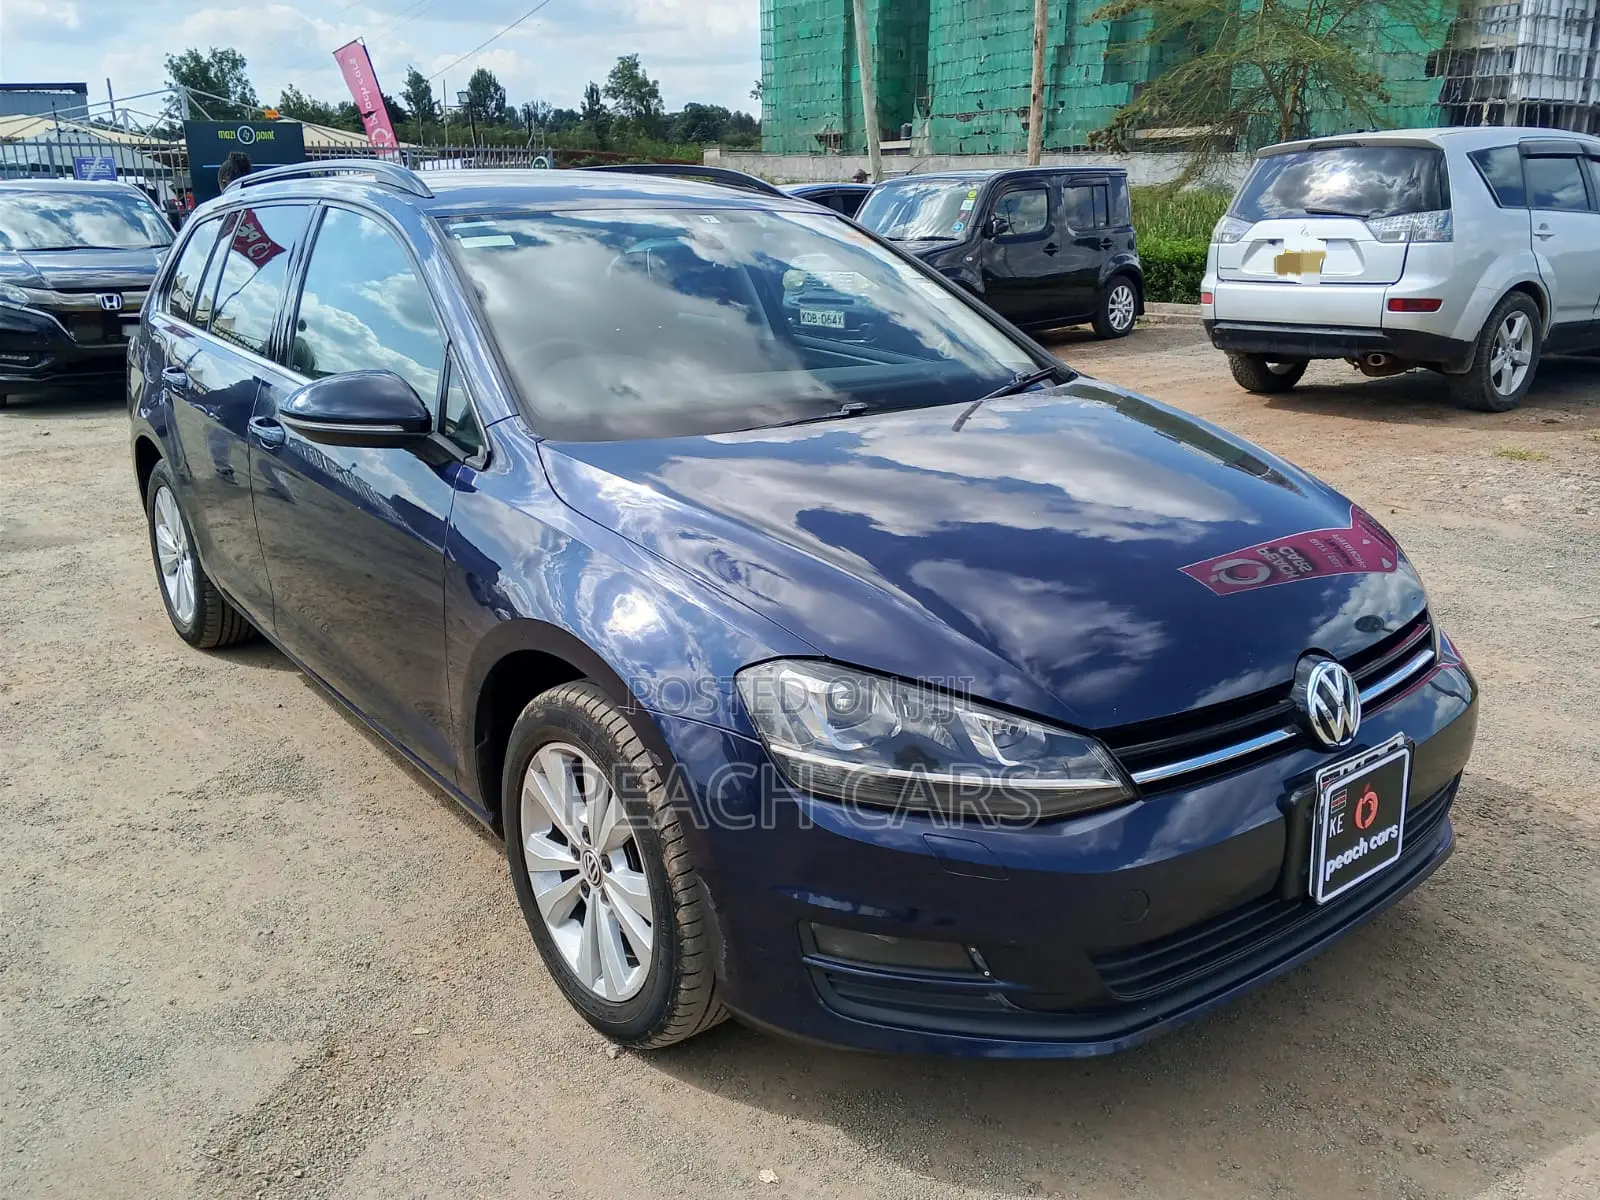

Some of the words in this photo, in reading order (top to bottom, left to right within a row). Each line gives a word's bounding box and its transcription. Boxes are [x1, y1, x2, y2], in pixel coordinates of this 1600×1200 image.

[256, 130, 275, 142] point
[1328, 812, 1346, 838] KE
[1325, 837, 1368, 882] peach
[1369, 824, 1399, 850] cars
